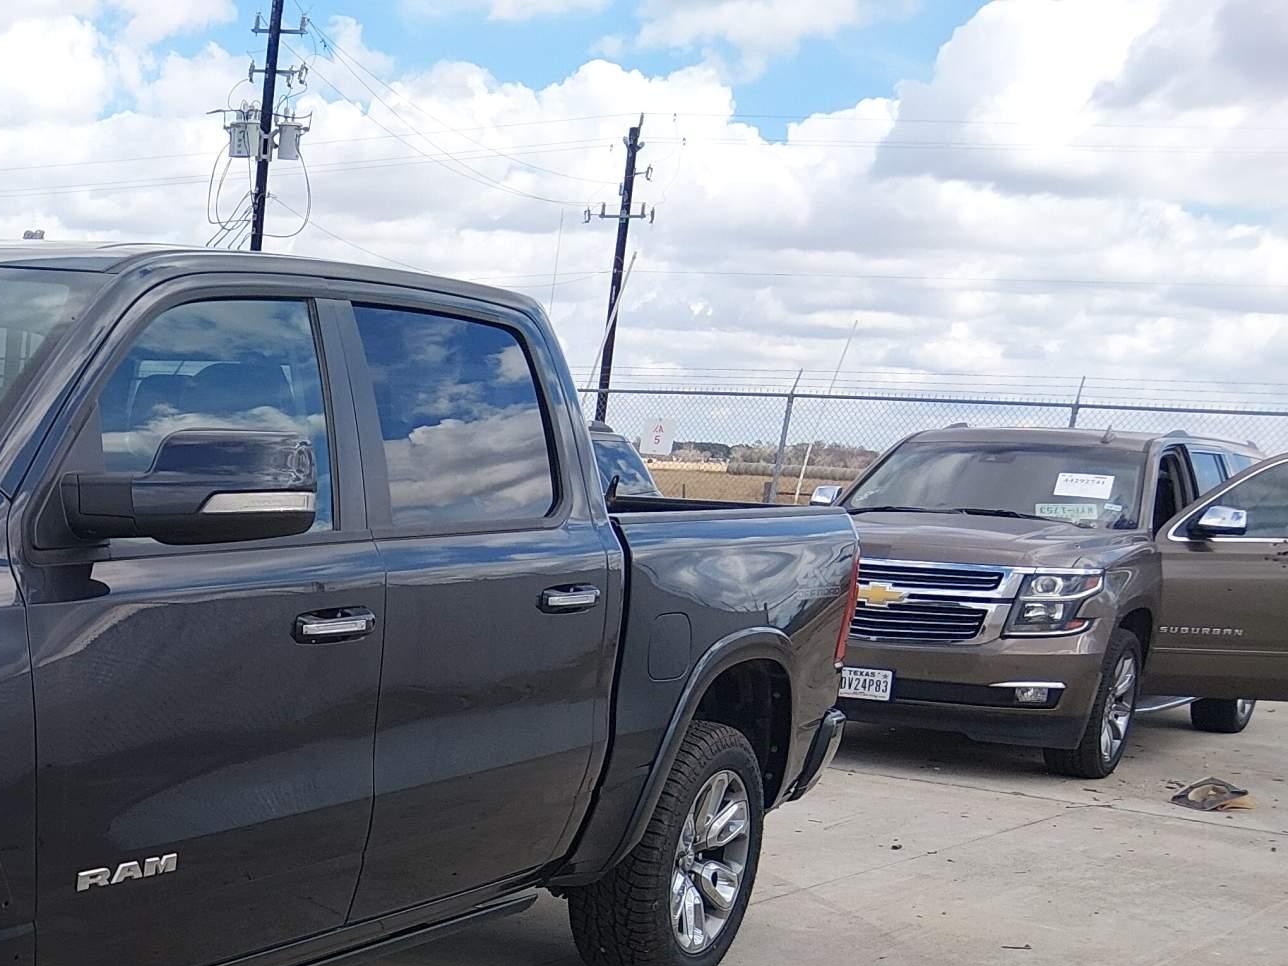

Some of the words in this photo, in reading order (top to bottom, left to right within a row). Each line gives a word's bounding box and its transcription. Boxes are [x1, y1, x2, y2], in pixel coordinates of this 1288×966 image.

[1159, 626, 1244, 636] SUBURBAN
[848, 669, 876, 678] TEXAS
[76, 852, 178, 892] RAM
